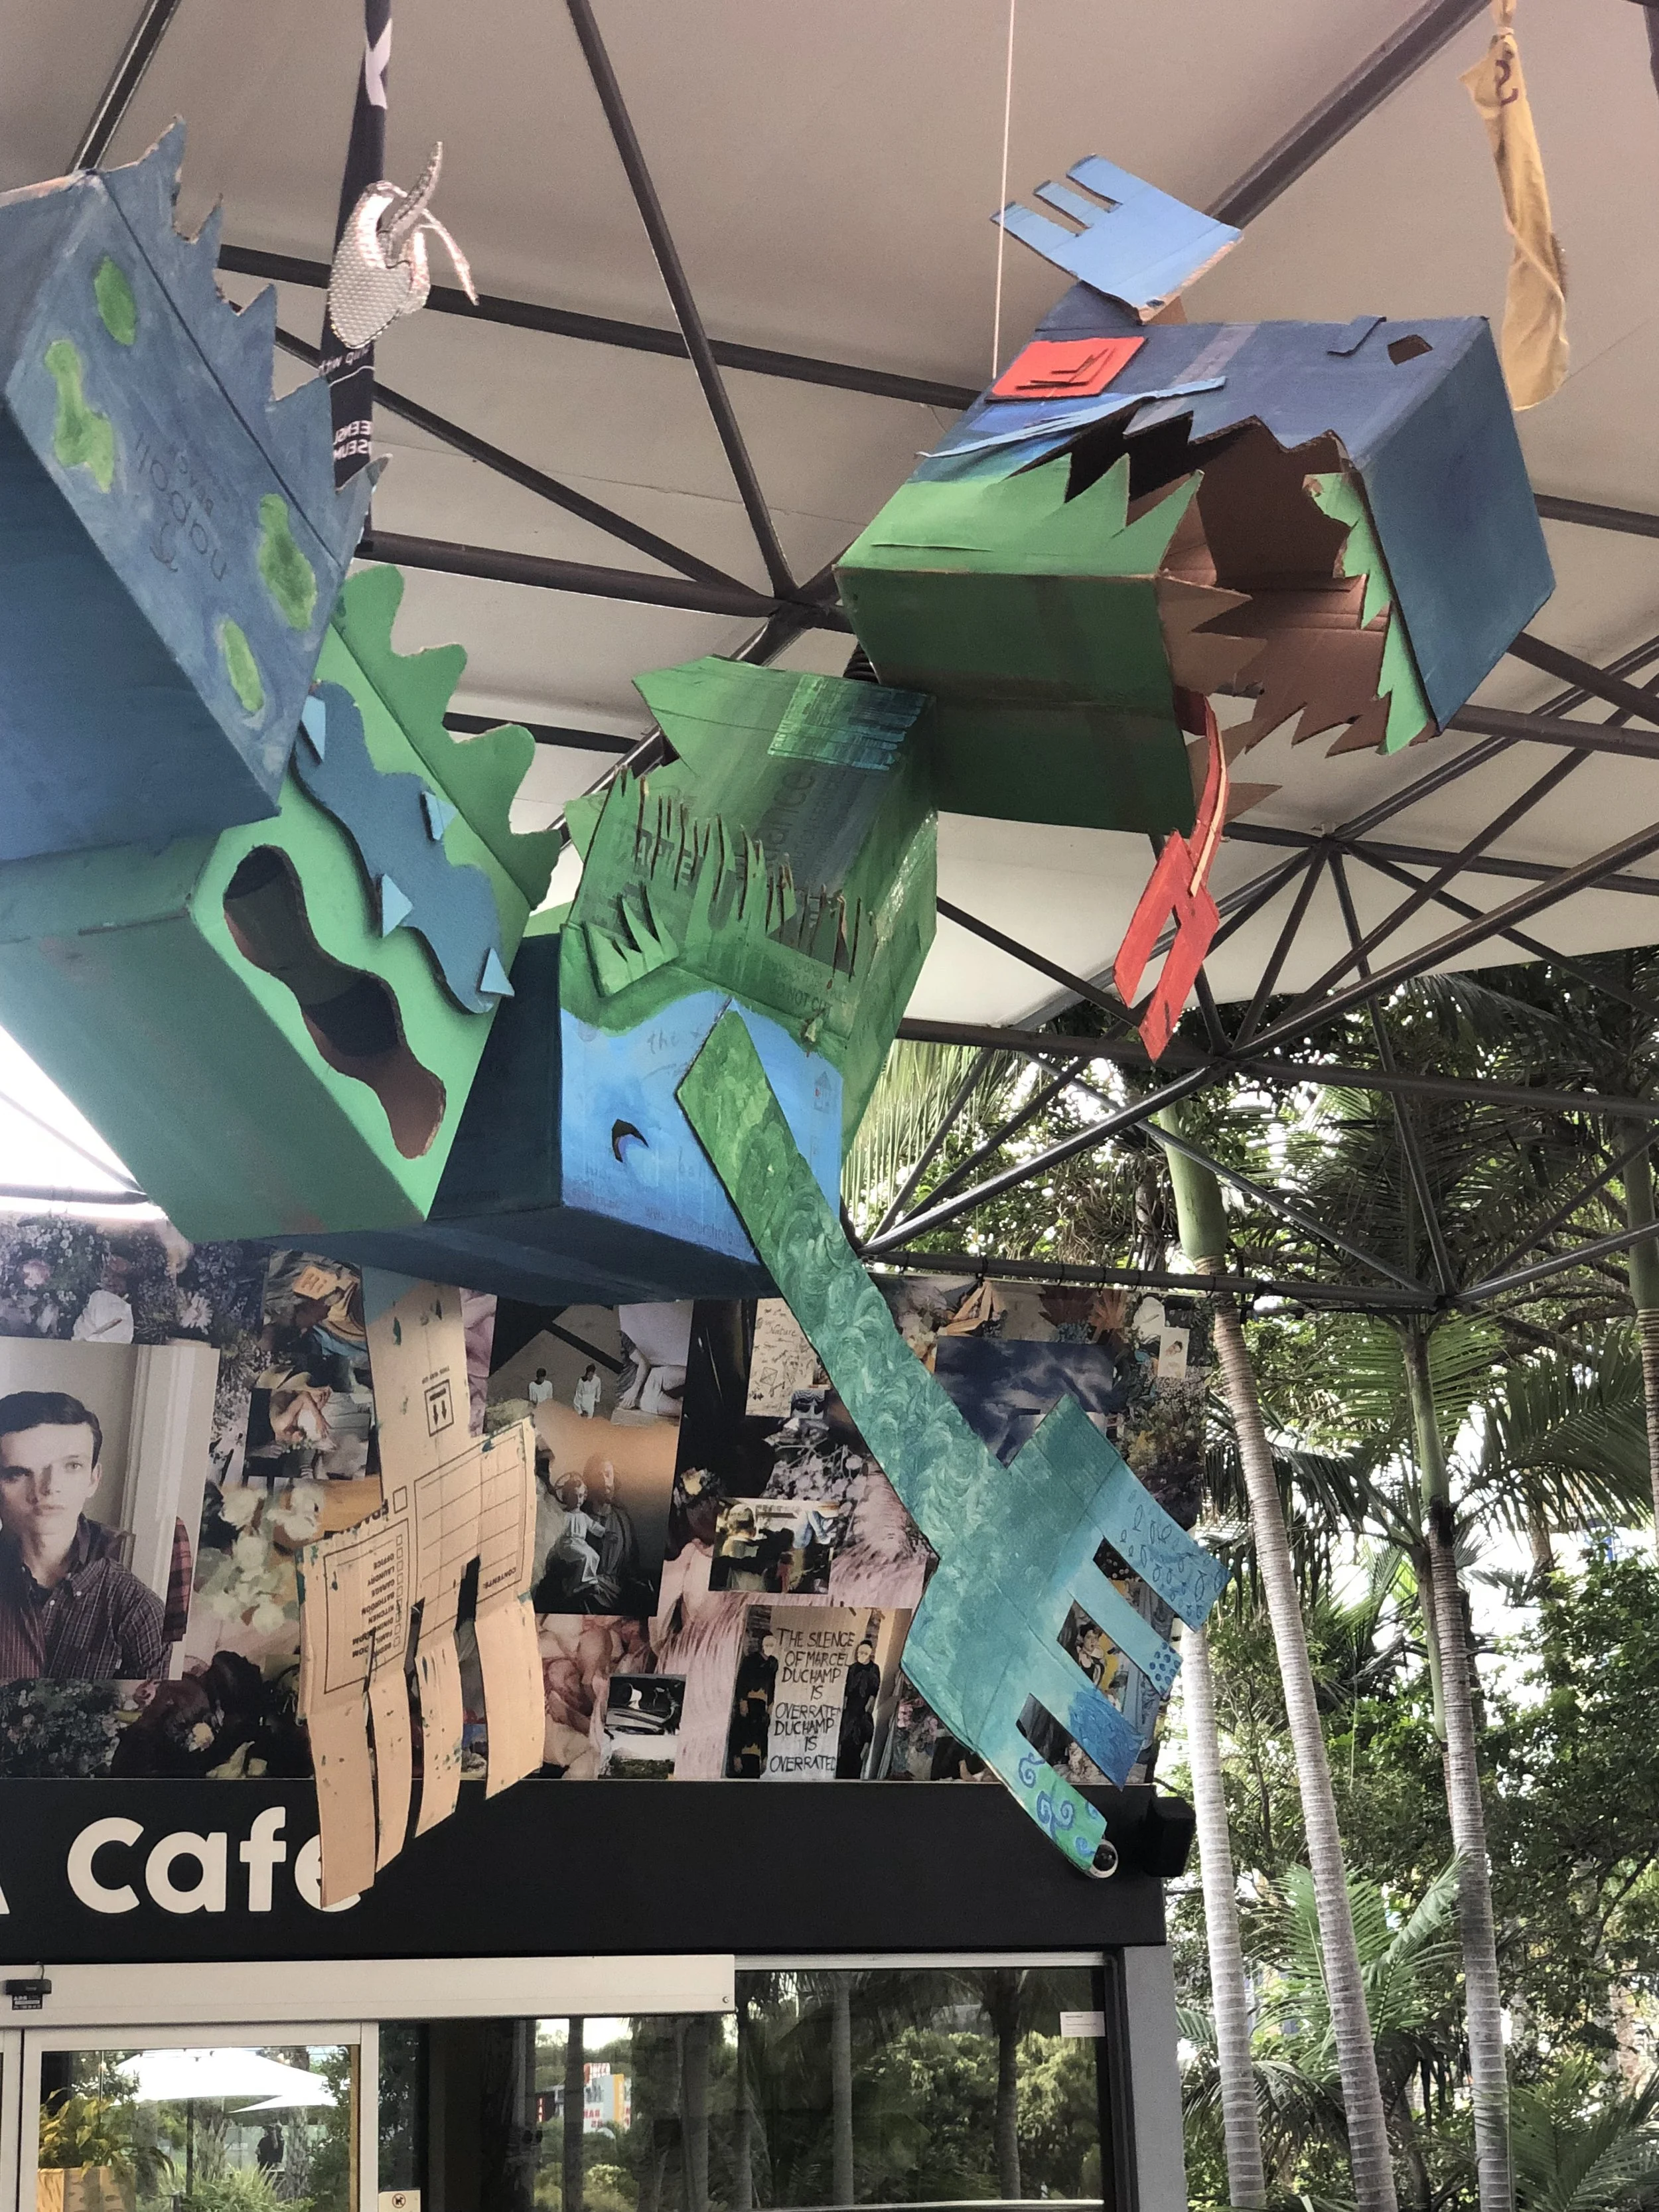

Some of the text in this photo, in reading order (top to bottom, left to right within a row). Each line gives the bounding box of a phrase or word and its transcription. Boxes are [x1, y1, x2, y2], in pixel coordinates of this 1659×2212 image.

[373, 1554, 395, 1570] OFFICE
[367, 1566, 395, 1587] LAUNDRY
[371, 1579, 395, 1598] GARAGE
[361, 1591, 395, 1615] BATHROOM
[368, 1605, 394, 1625] KITCHEN
[776, 1628, 855, 1649] THE SILENCE
[784, 1651, 850, 1668] OF MARCEL
[782, 1666, 841, 1683] DUCHAMP
[810, 1685, 823, 1701] IS
[774, 1718, 835, 1736] DUCHAMP
[804, 1735, 818, 1752] IS
